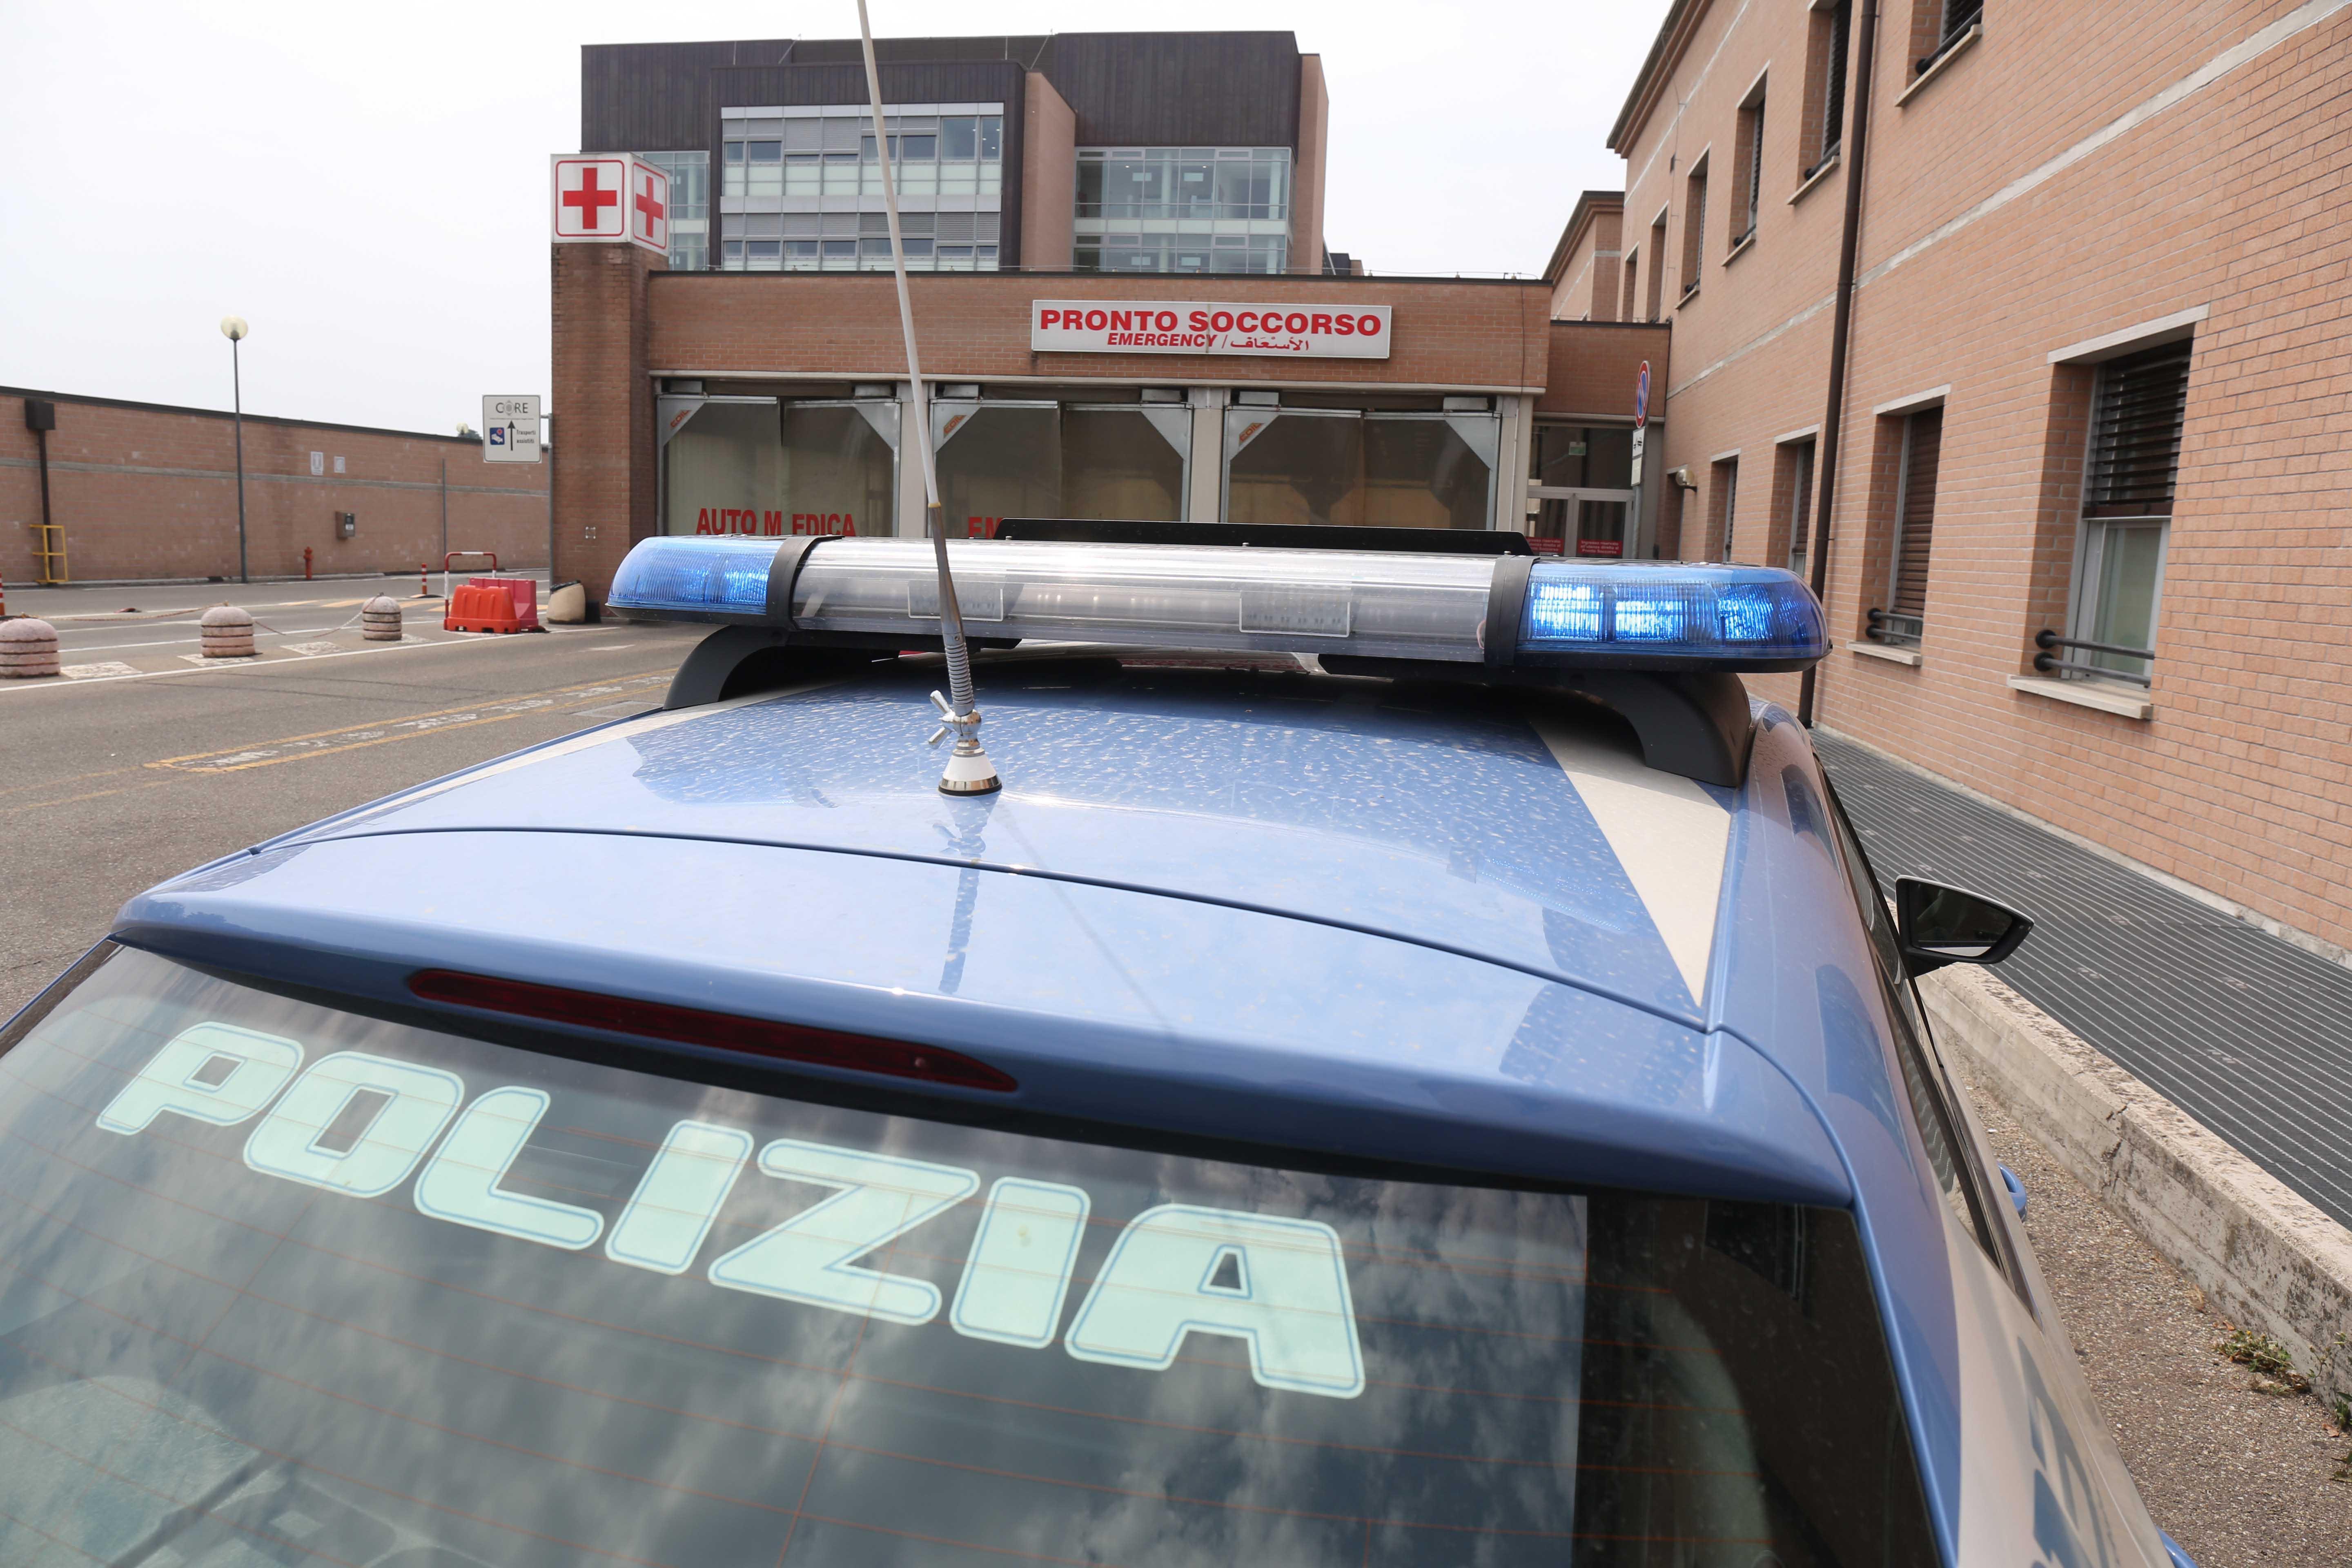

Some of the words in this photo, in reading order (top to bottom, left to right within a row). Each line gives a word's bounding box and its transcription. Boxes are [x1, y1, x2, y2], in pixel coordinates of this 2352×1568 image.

[1041, 310, 1178, 332] PRONTO
[1189, 311, 1381, 336] SOCCORSO
[1107, 332, 1217, 347] EMERGENCY
[496, 399, 529, 416] CORE
[696, 508, 757, 535] AUTO
[96, 1021, 1365, 1398] POLIZIA
